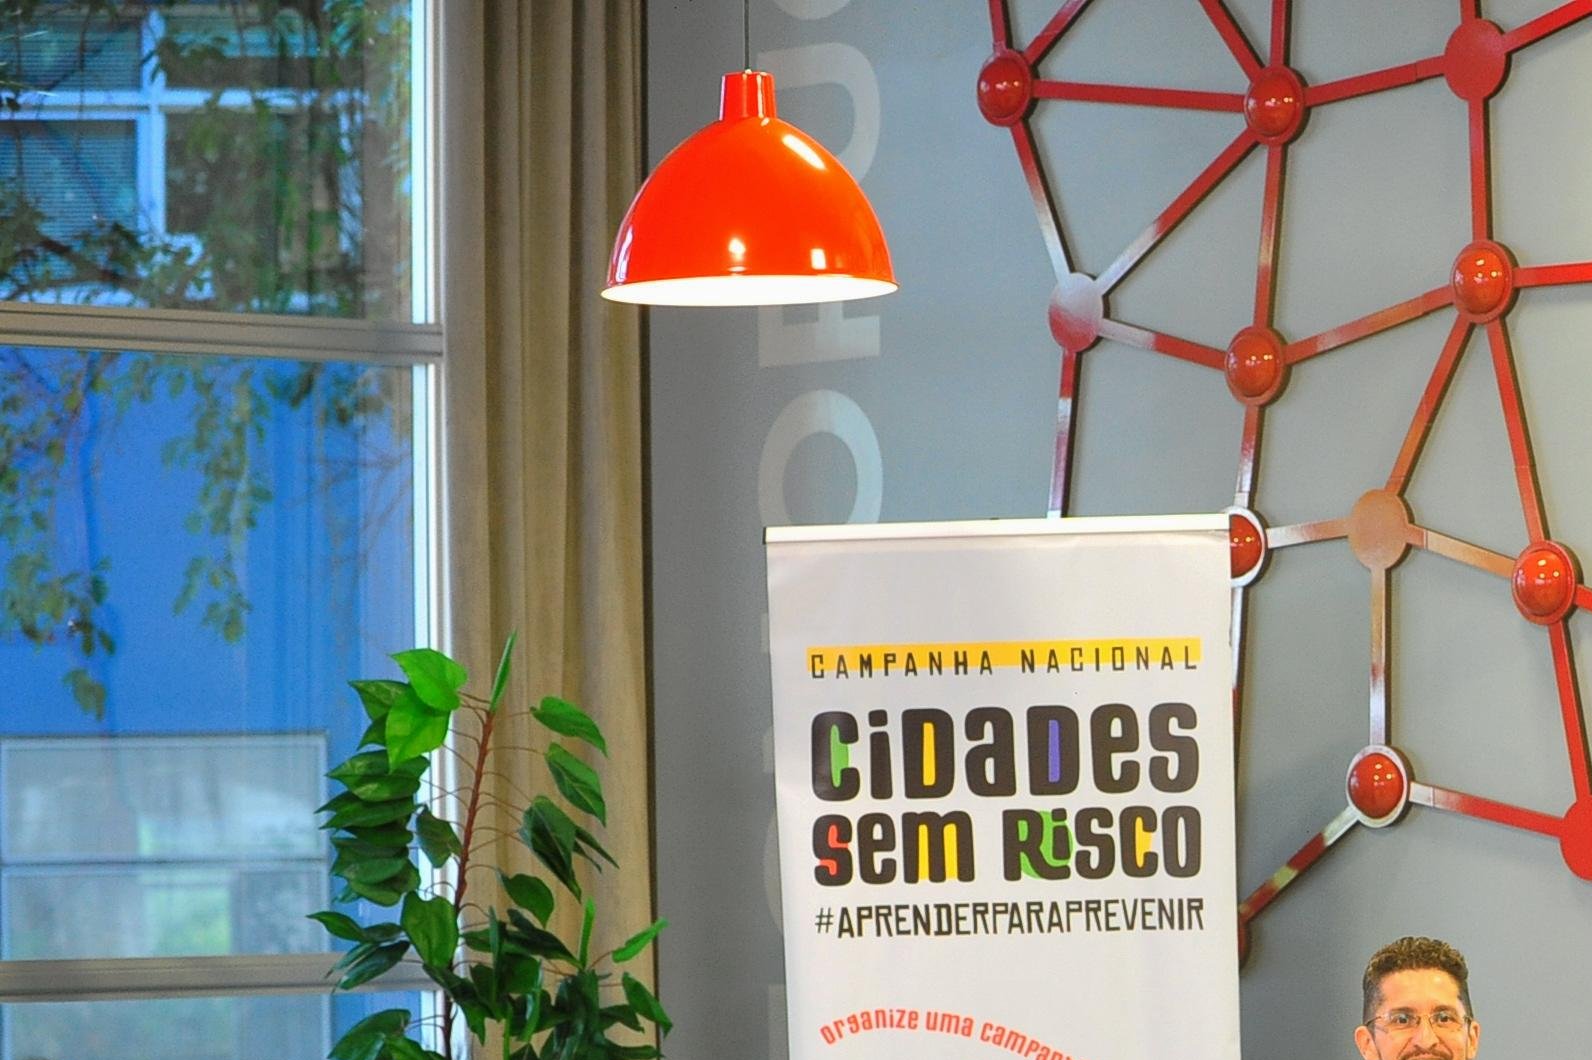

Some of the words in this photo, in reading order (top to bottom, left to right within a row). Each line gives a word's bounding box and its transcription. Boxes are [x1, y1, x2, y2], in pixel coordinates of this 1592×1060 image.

[811, 651, 992, 678] CAMPANHA
[1021, 645, 1197, 673] NACIONAL
[815, 898, 1204, 938] #APRENDERPARAPREVENIR
[820, 1009, 919, 1045] organize
[925, 1011, 973, 1037] uma
